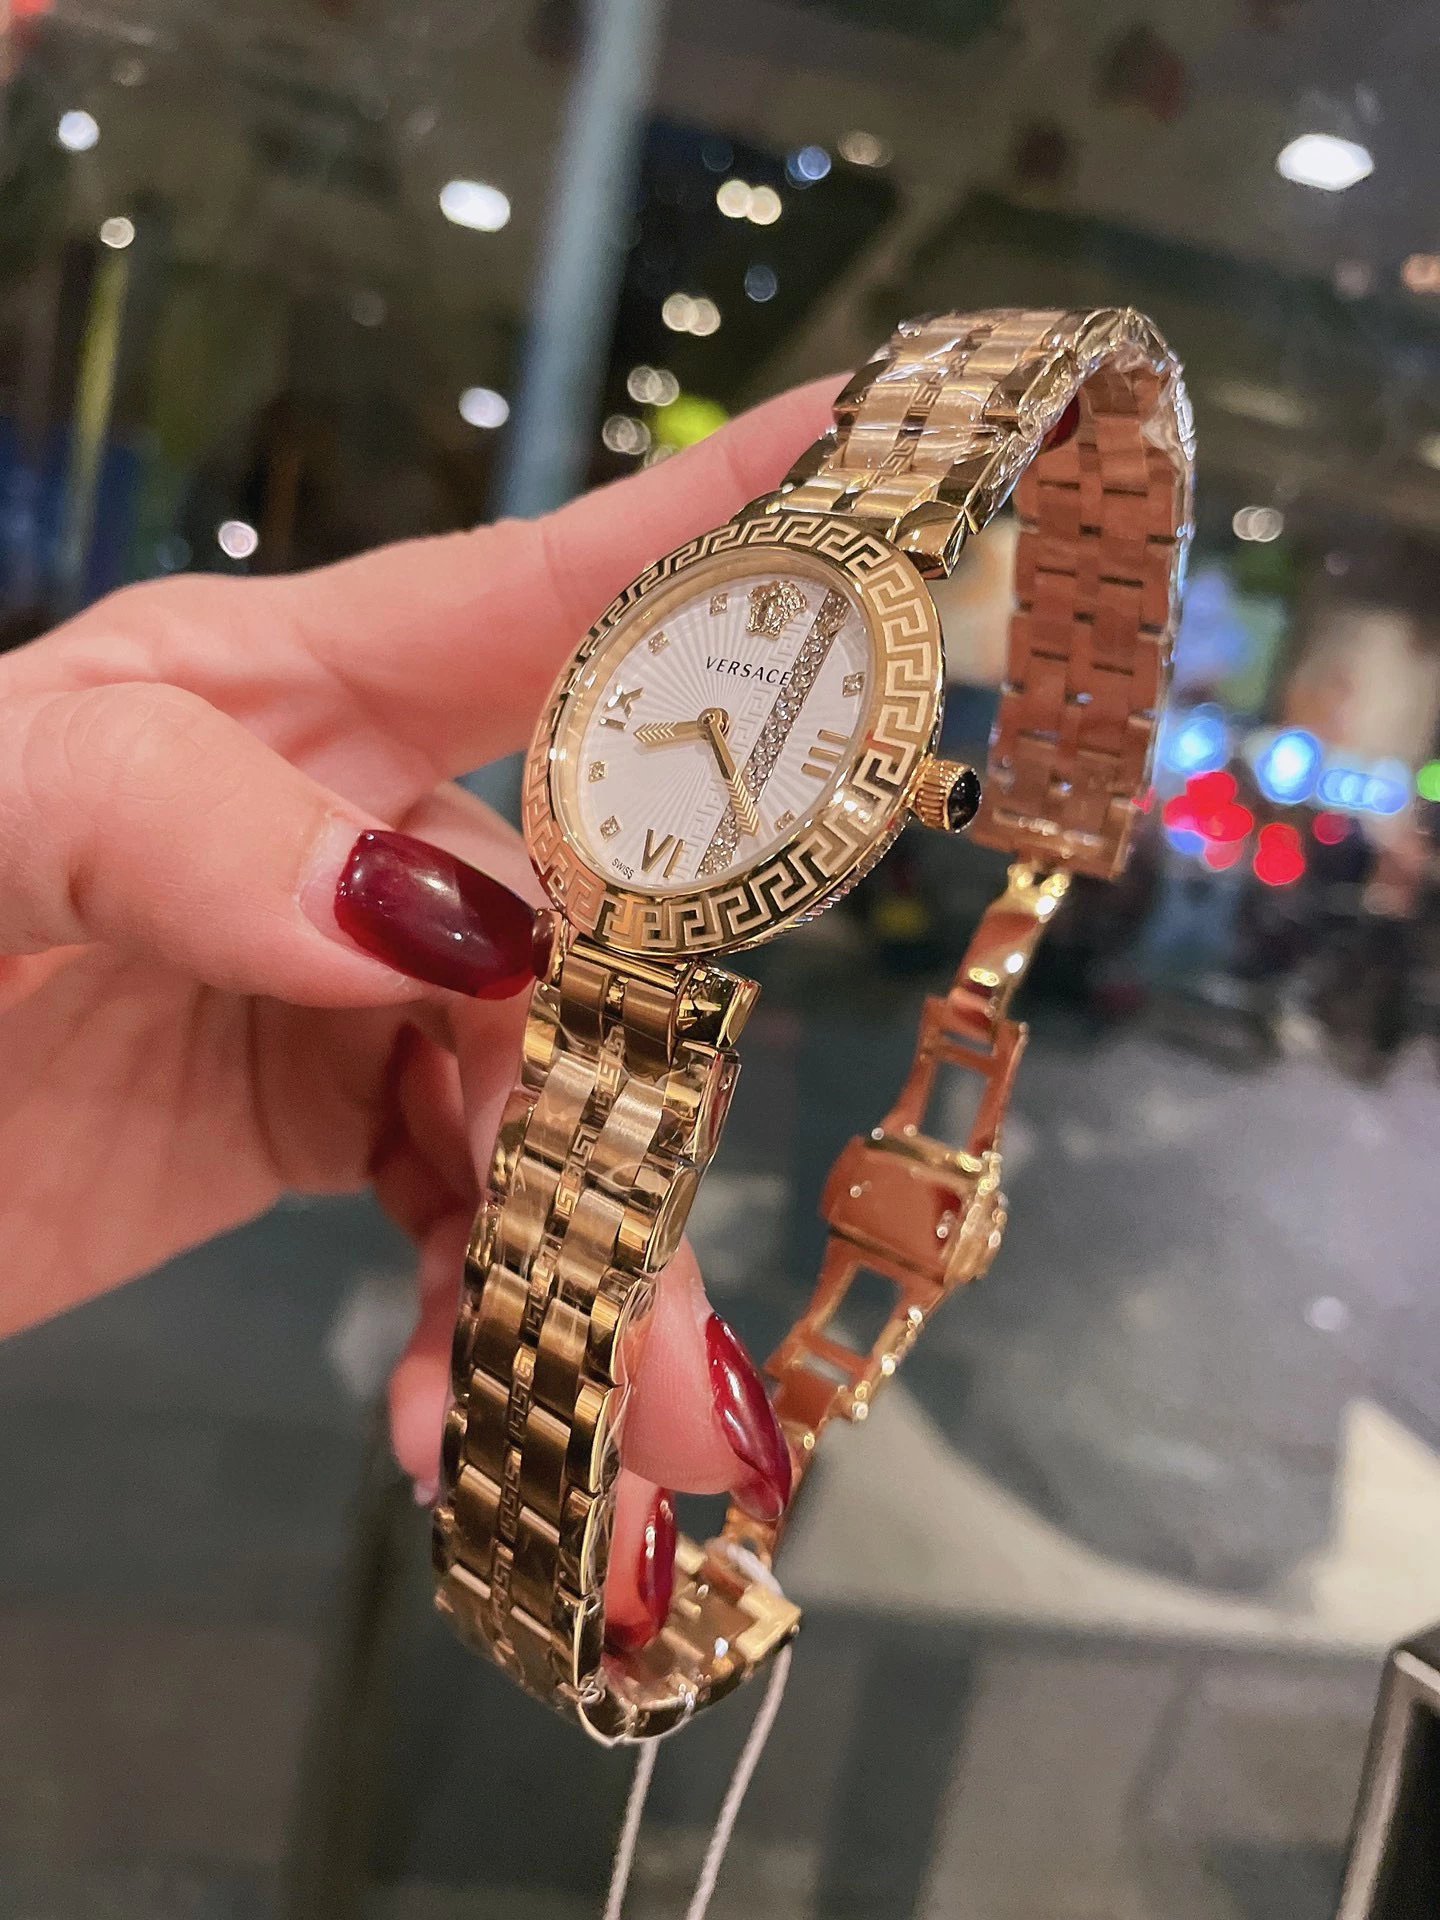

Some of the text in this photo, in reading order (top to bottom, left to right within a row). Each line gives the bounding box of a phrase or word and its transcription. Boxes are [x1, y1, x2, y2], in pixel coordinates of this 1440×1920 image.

[706, 656, 792, 686] VERSACE
[801, 729, 849, 780] III
[611, 857, 634, 880] SWISS
[641, 829, 685, 878] VI
